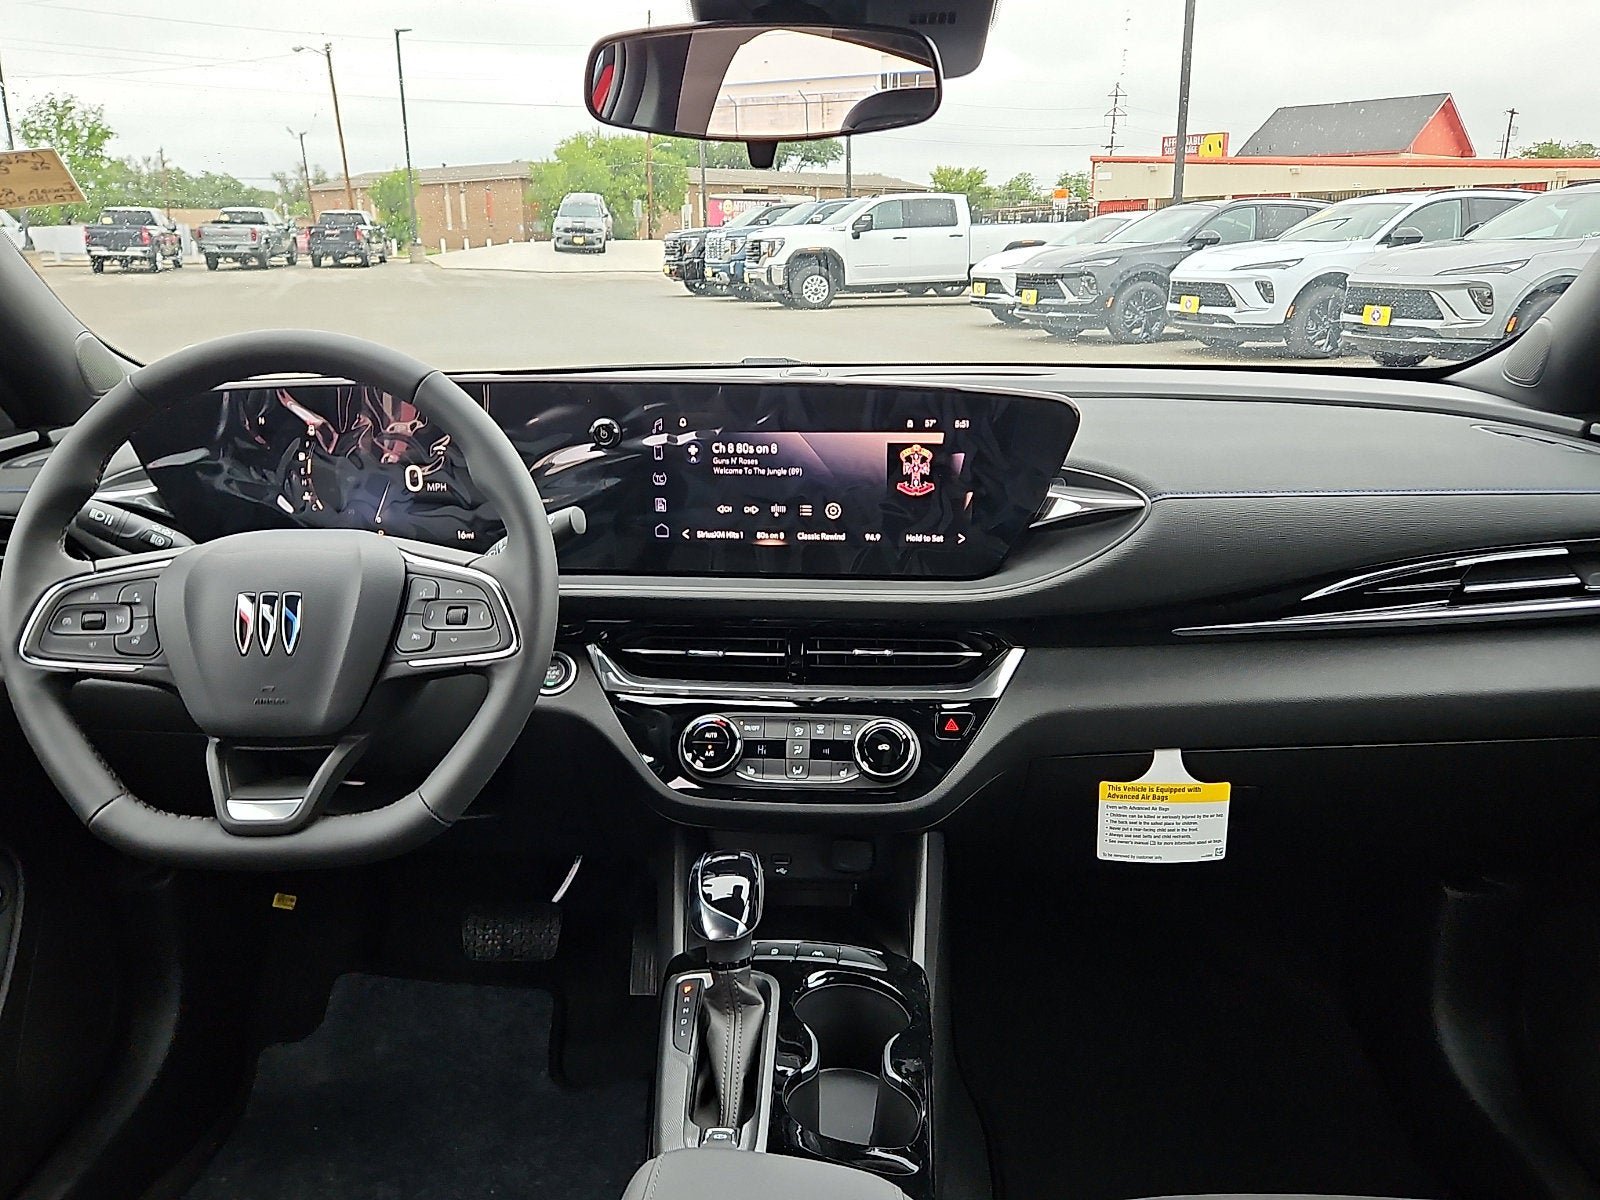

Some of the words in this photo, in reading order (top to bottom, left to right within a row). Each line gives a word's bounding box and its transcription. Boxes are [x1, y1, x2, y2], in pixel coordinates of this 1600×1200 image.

[1164, 136, 1204, 148] AFFDABLE
[712, 442, 725, 454] Ch
[728, 443, 734, 454] 8
[736, 443, 754, 454] 80s
[756, 446, 769, 454] on
[770, 443, 778, 454] 8
[766, 468, 787, 476] Jungle
[405, 464, 423, 492] 0
[427, 482, 447, 491] MPH
[458, 530, 474, 539] 16mi
[797, 532, 820, 540] Classic
[821, 533, 846, 541] Rewind
[906, 534, 922, 542] Hold
[757, 745, 767, 755] Hi
